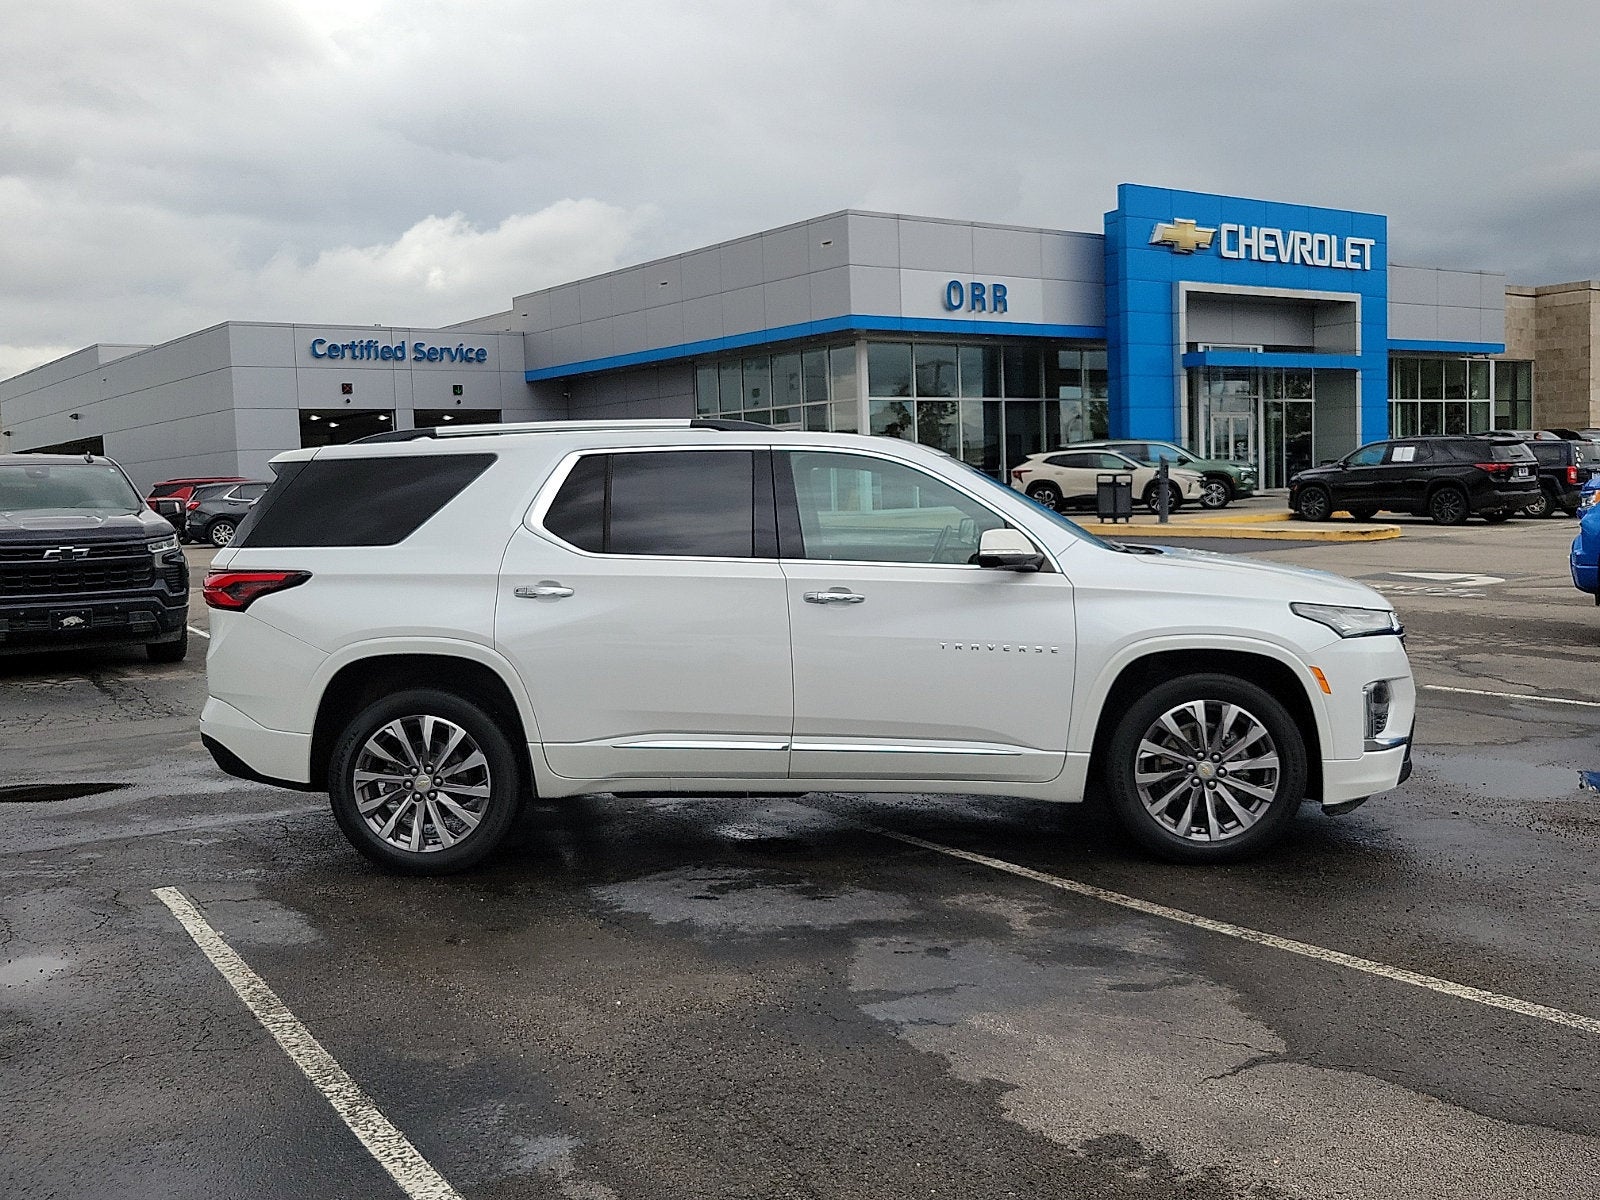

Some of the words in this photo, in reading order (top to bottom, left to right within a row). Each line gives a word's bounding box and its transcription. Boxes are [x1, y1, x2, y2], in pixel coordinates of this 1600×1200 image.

[1219, 222, 1376, 271] CHEVROLET
[944, 279, 1008, 313] ORR
[311, 337, 406, 361] Certified
[412, 341, 488, 363] Service
[939, 641, 1060, 654] TRAVERSE
